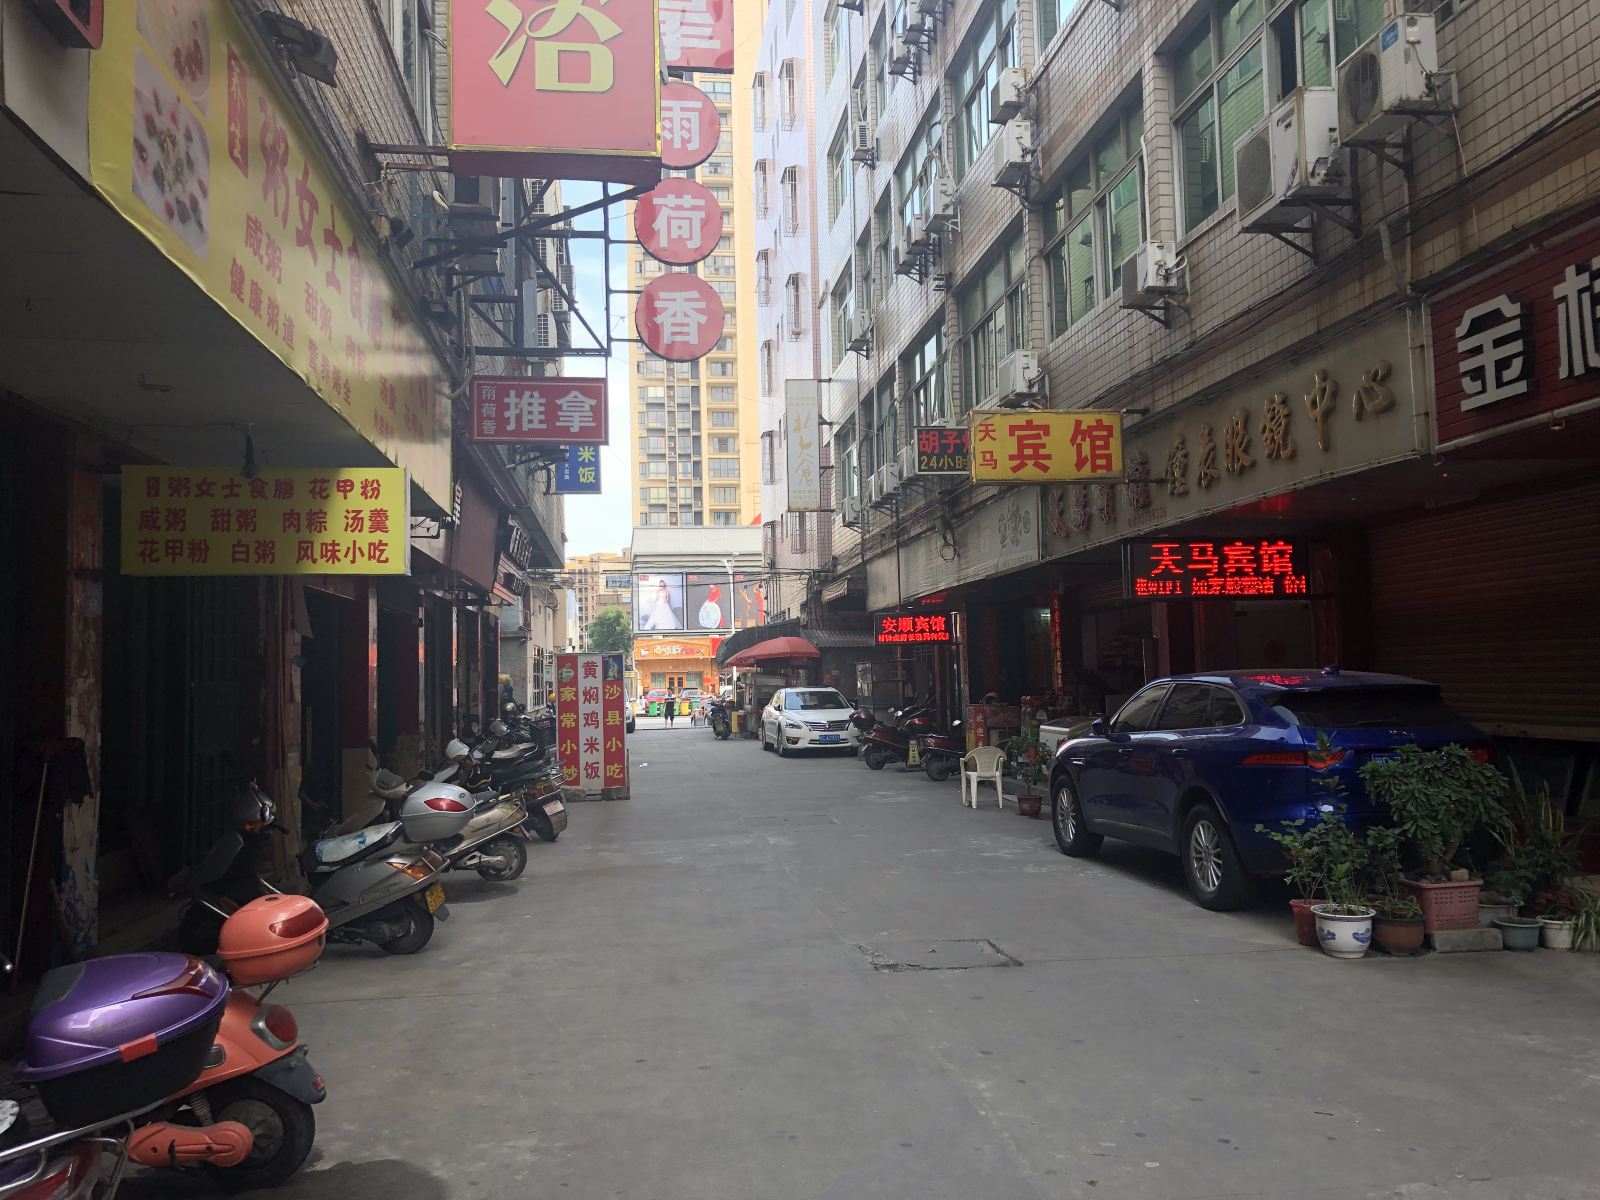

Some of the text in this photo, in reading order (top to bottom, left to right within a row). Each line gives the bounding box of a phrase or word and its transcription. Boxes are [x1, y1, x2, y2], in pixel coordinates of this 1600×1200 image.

[481, 385, 497, 435] 雨荷香
[503, 389, 598, 433] 推拿
[577, 446, 596, 484] 米饭
[978, 423, 998, 470] 天马
[1008, 419, 1114, 475] 宾馆
[308, 478, 381, 500] 花甲粉
[138, 507, 390, 534] 咸粥 甜粥 肉粽 汤羹
[139, 539, 389, 565] 花甲粉 白粥 风味小吃
[1150, 540, 1293, 577] 天马宾馆
[881, 615, 946, 633] 安顺宾馆
[560, 687, 579, 781] 家常小炒
[582, 661, 600, 780] 黄焖鸡米饭
[605, 684, 623, 779] 沙县小吃
